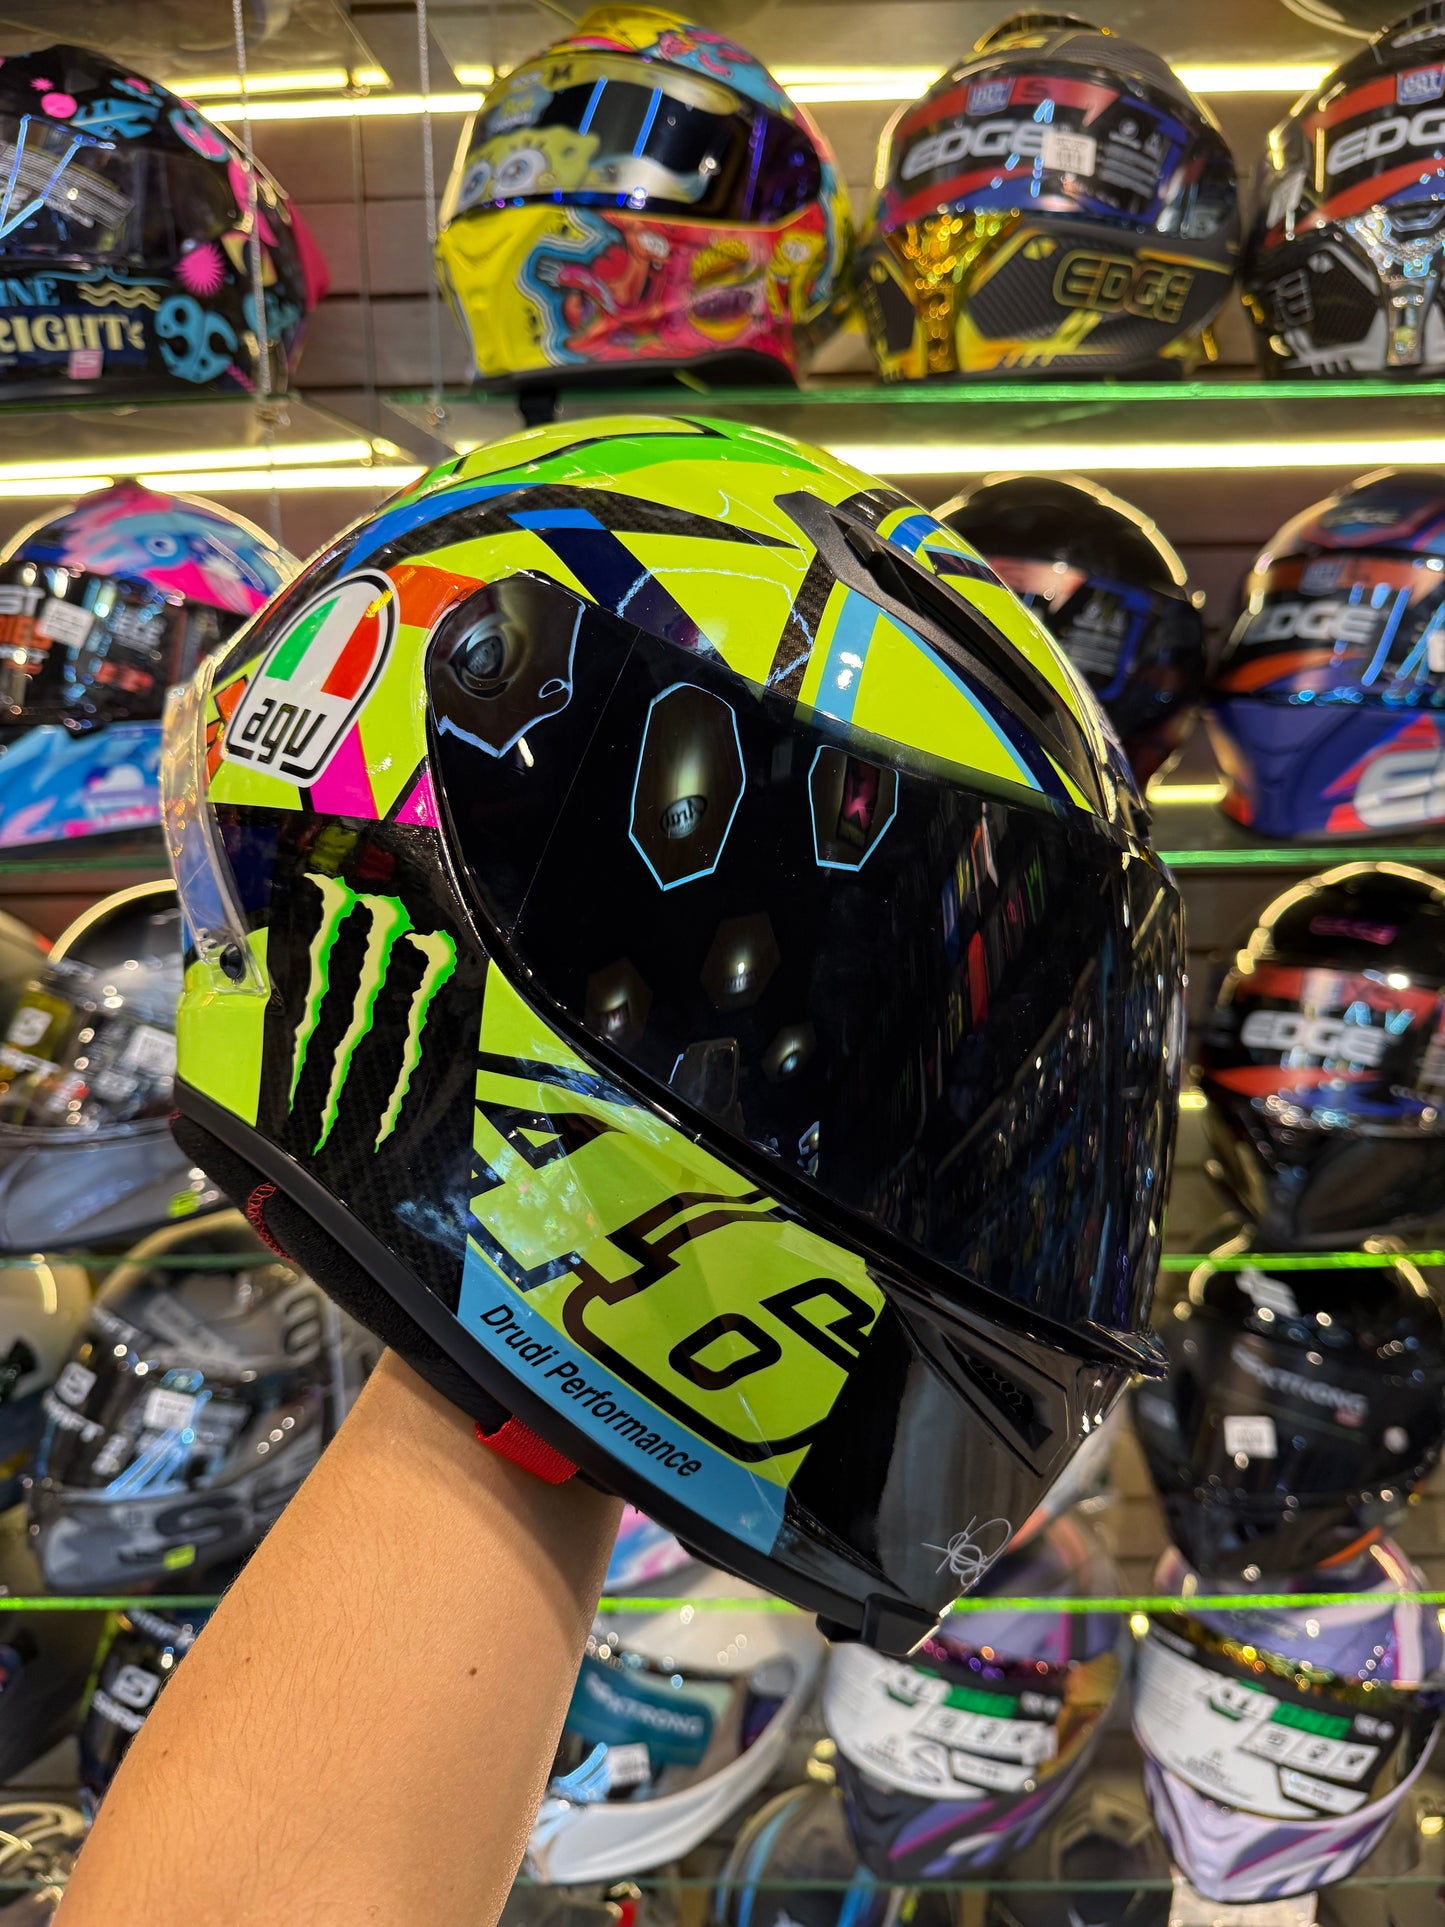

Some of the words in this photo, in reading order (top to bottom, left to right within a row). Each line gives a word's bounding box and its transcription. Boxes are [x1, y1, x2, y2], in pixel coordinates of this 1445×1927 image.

[901, 119, 1050, 180] EDGE
[1052, 249, 1195, 325] EDGE
[241, 697, 327, 764] agv
[1241, 1010, 1386, 1067] EDGE
[480, 1304, 559, 1367] Drudi
[544, 1360, 702, 1477] Performance
